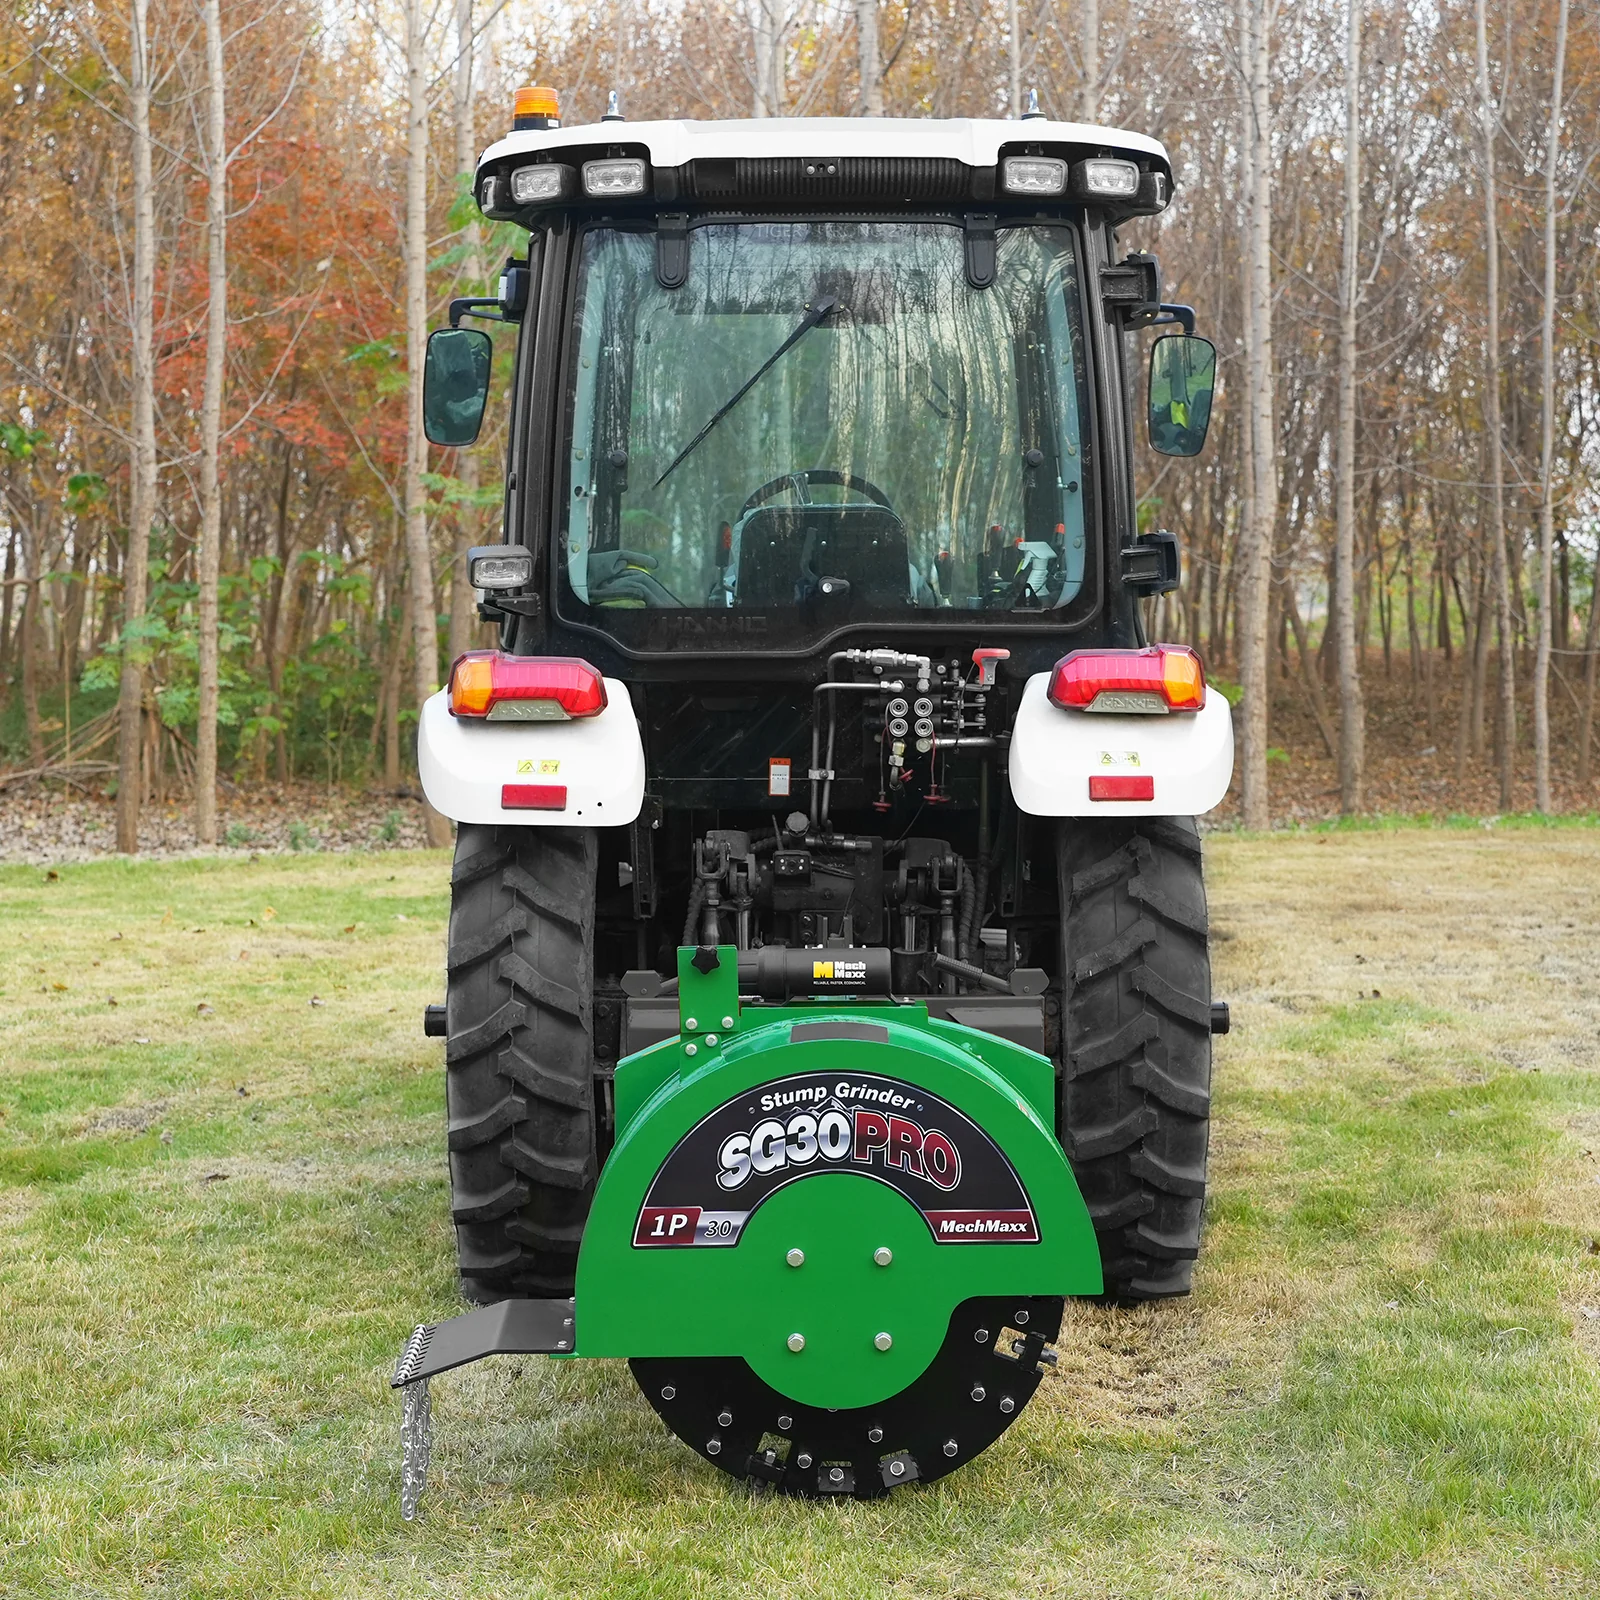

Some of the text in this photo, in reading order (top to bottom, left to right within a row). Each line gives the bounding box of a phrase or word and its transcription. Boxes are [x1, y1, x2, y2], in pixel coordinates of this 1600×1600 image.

[756, 225, 803, 238] TIGER
[834, 961, 867, 970] Mech
[834, 970, 866, 978] Maxx
[761, 1082, 915, 1112] Stump Grinder
[650, 1214, 732, 1238] 1P 30
[940, 1219, 1028, 1233] MechMaxx
